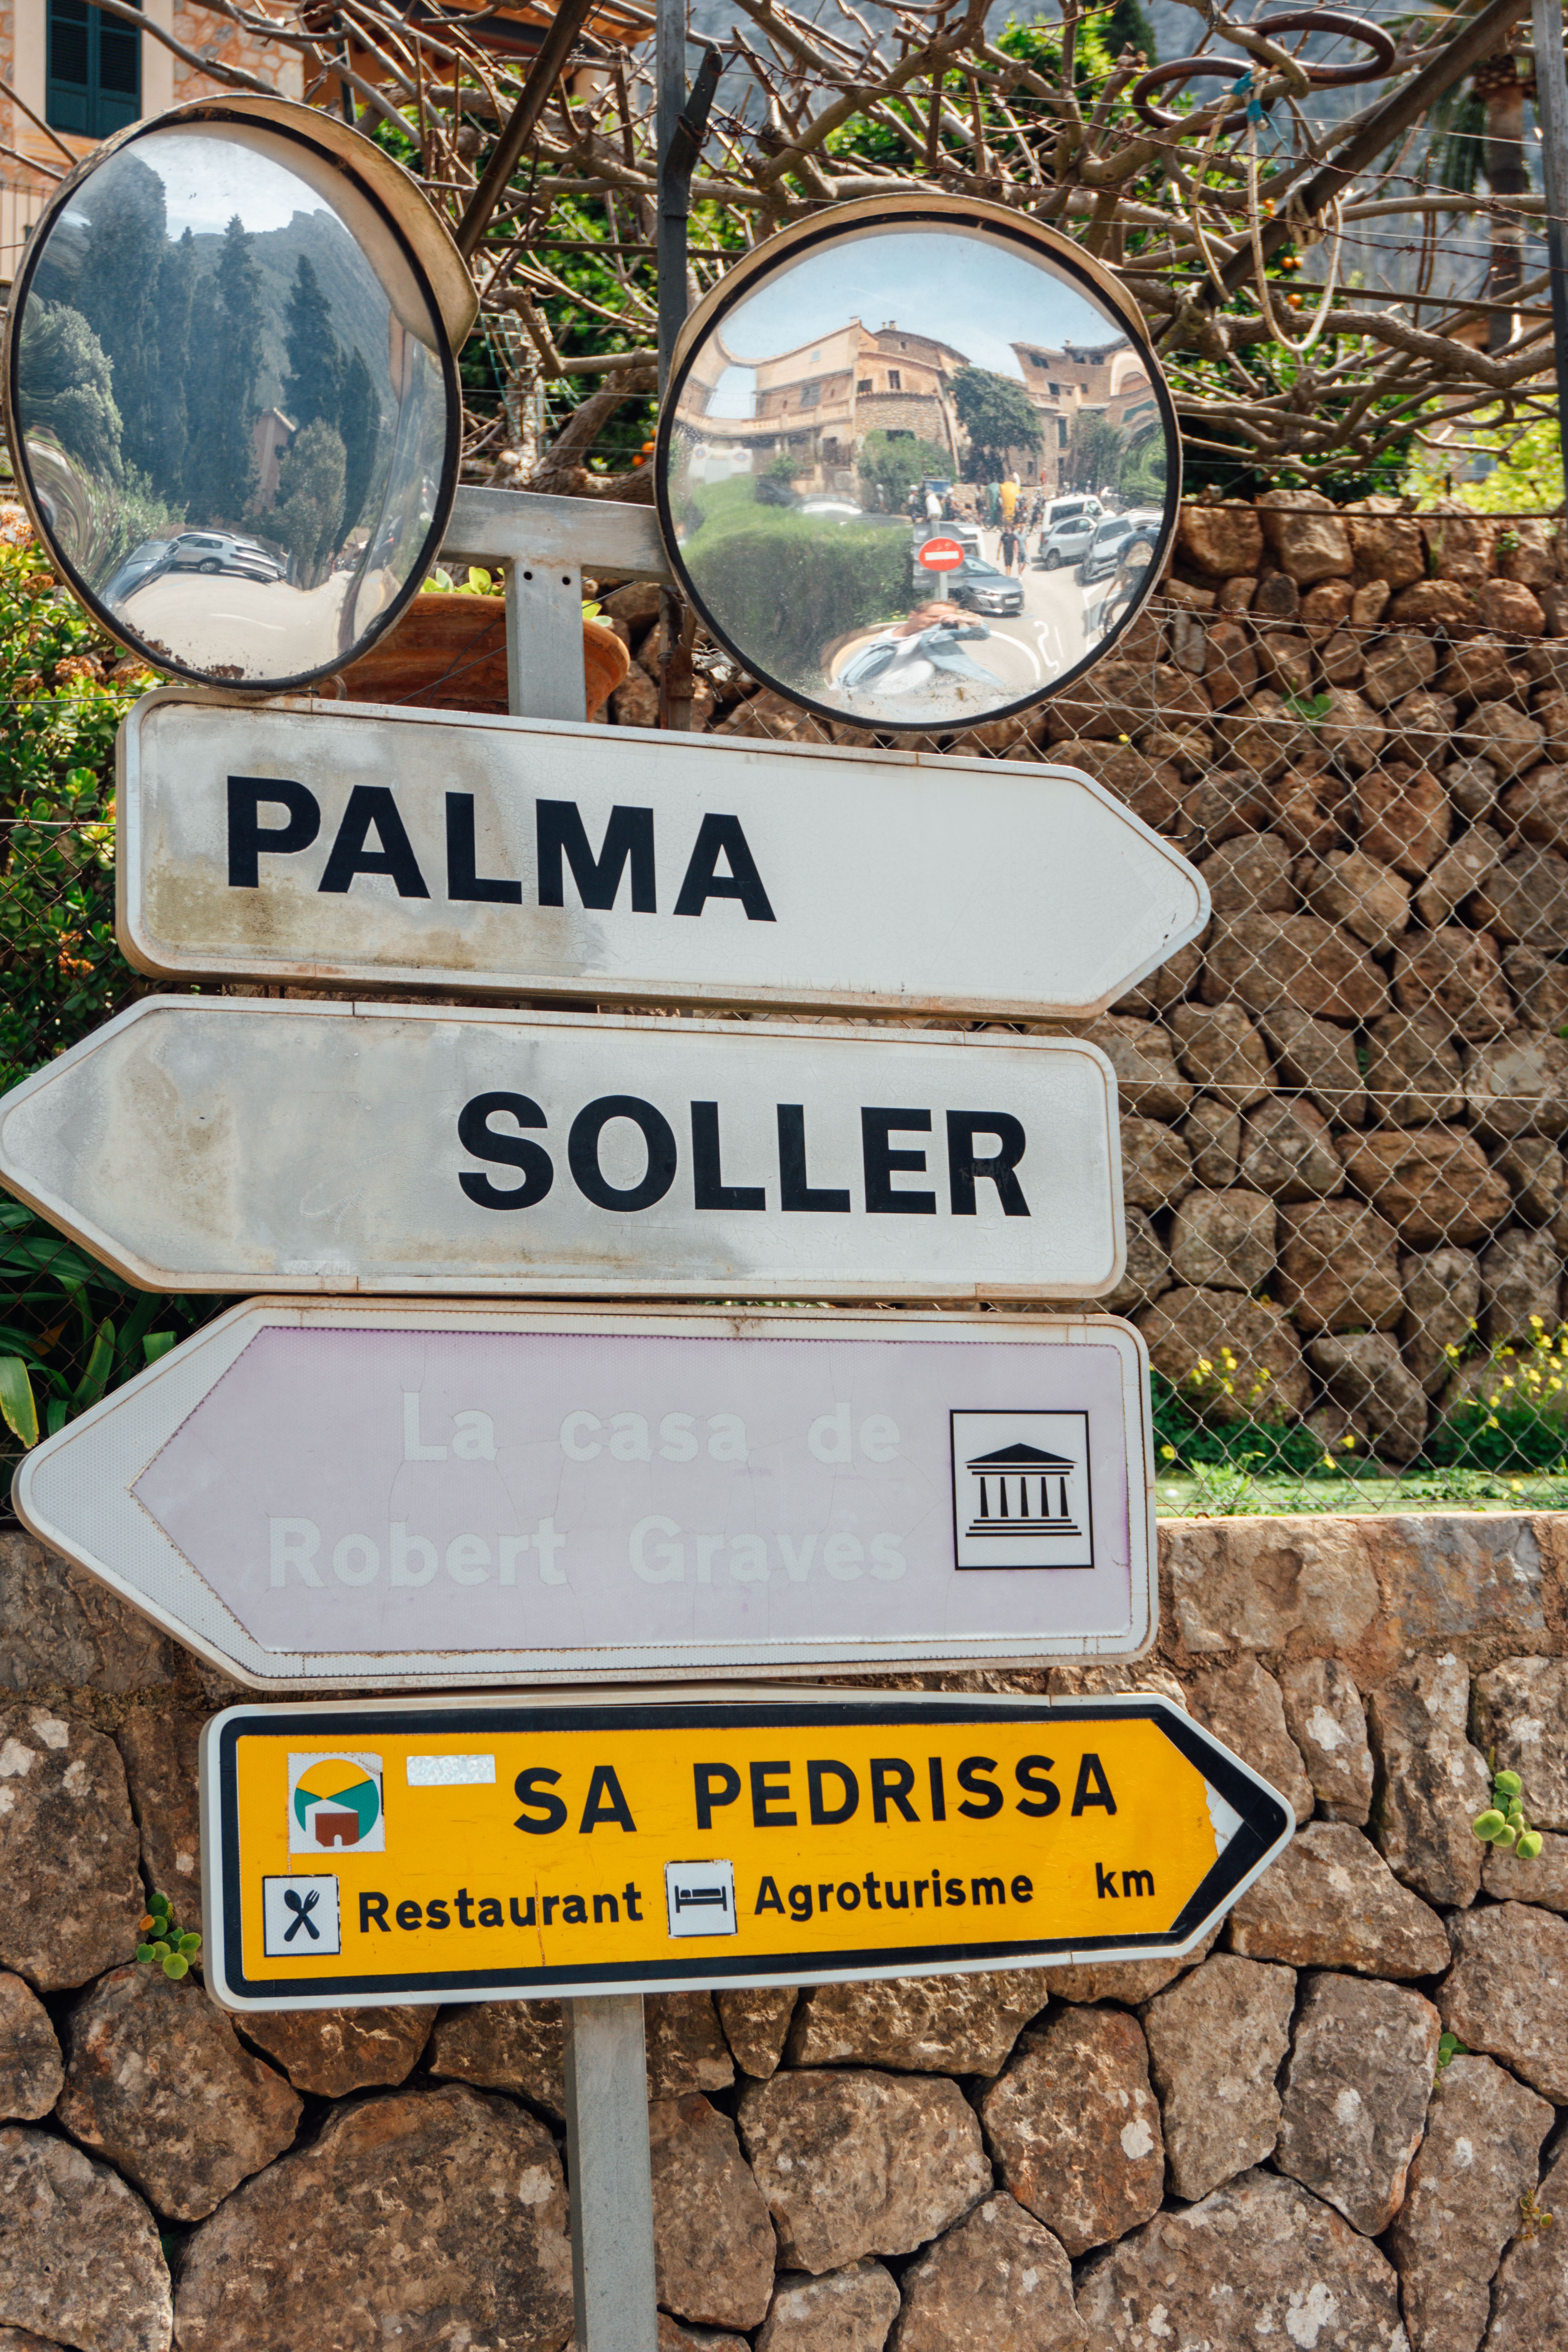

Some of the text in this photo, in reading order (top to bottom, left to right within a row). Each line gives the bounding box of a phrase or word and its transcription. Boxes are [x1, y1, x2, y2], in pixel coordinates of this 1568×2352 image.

[227, 775, 777, 922] PALMA
[457, 1091, 1031, 1217] SOLLER
[403, 1390, 900, 1464] La casa de
[269, 1515, 568, 1588] Robert
[514, 1753, 1117, 1835] SA PEDRISSA
[359, 1862, 1155, 1933] Restaurant Agroturisme km
